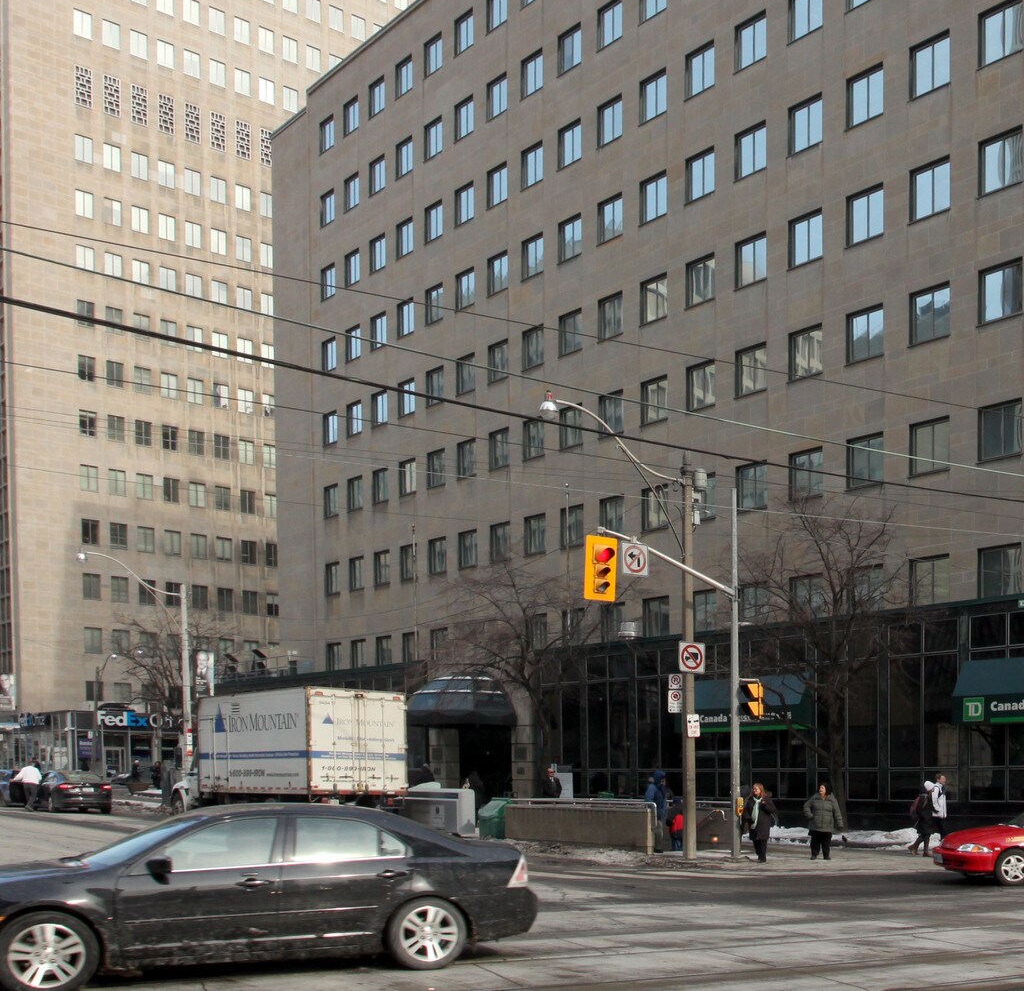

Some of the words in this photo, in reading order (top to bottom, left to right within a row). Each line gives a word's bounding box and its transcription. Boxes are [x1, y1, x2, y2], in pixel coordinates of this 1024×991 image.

[966, 701, 982, 716] TD
[97, 710, 148, 727] FedEx
[228, 715, 248, 732] IRON
[249, 712, 297, 731] MOUNTAIN
[700, 714, 727, 723] Canada
